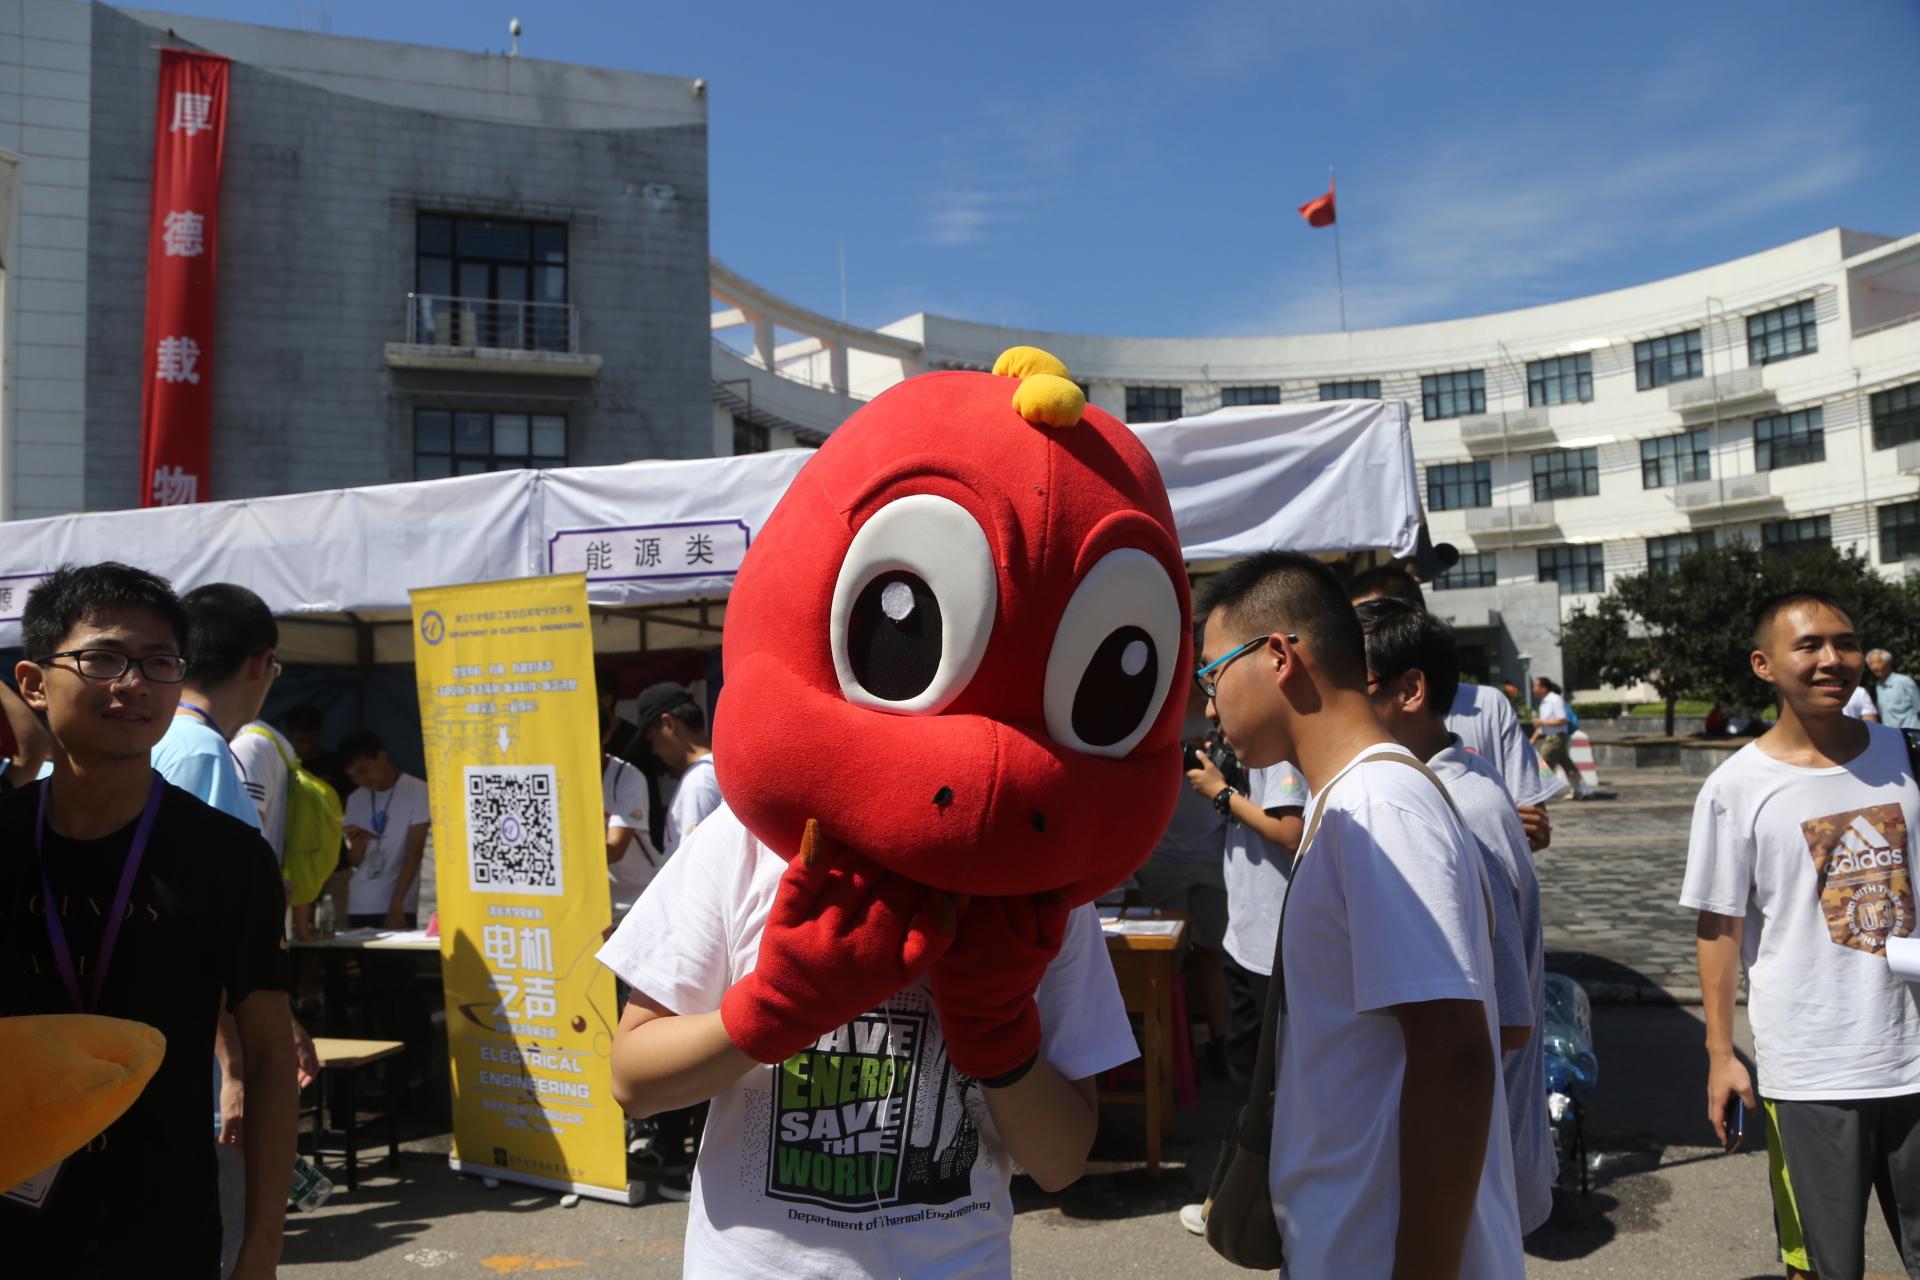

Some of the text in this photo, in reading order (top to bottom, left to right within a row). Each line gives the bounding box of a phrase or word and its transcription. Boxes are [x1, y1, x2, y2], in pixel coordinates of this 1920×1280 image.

[152, 92, 213, 505] 厚德载物
[586, 533, 714, 570] 能源类
[449, 621, 585, 639] DEPARTMENT OF ELECTRICAL ENGINEERING
[1824, 848, 1903, 876] adidas
[1851, 884, 1877, 901] WITH
[482, 924, 554, 973] 电机
[488, 973, 557, 1021] 之声
[803, 1021, 914, 1057] AVE
[480, 1045, 582, 1073] ELECTRICAL
[480, 1071, 590, 1099] ENGINEERING
[782, 1053, 912, 1109] ENERGY
[780, 1097, 903, 1142] SAVE
[821, 1129, 898, 1155] THE
[777, 1146, 894, 1196] WORLD
[788, 1200, 991, 1231] Department of Thermal Engineering
